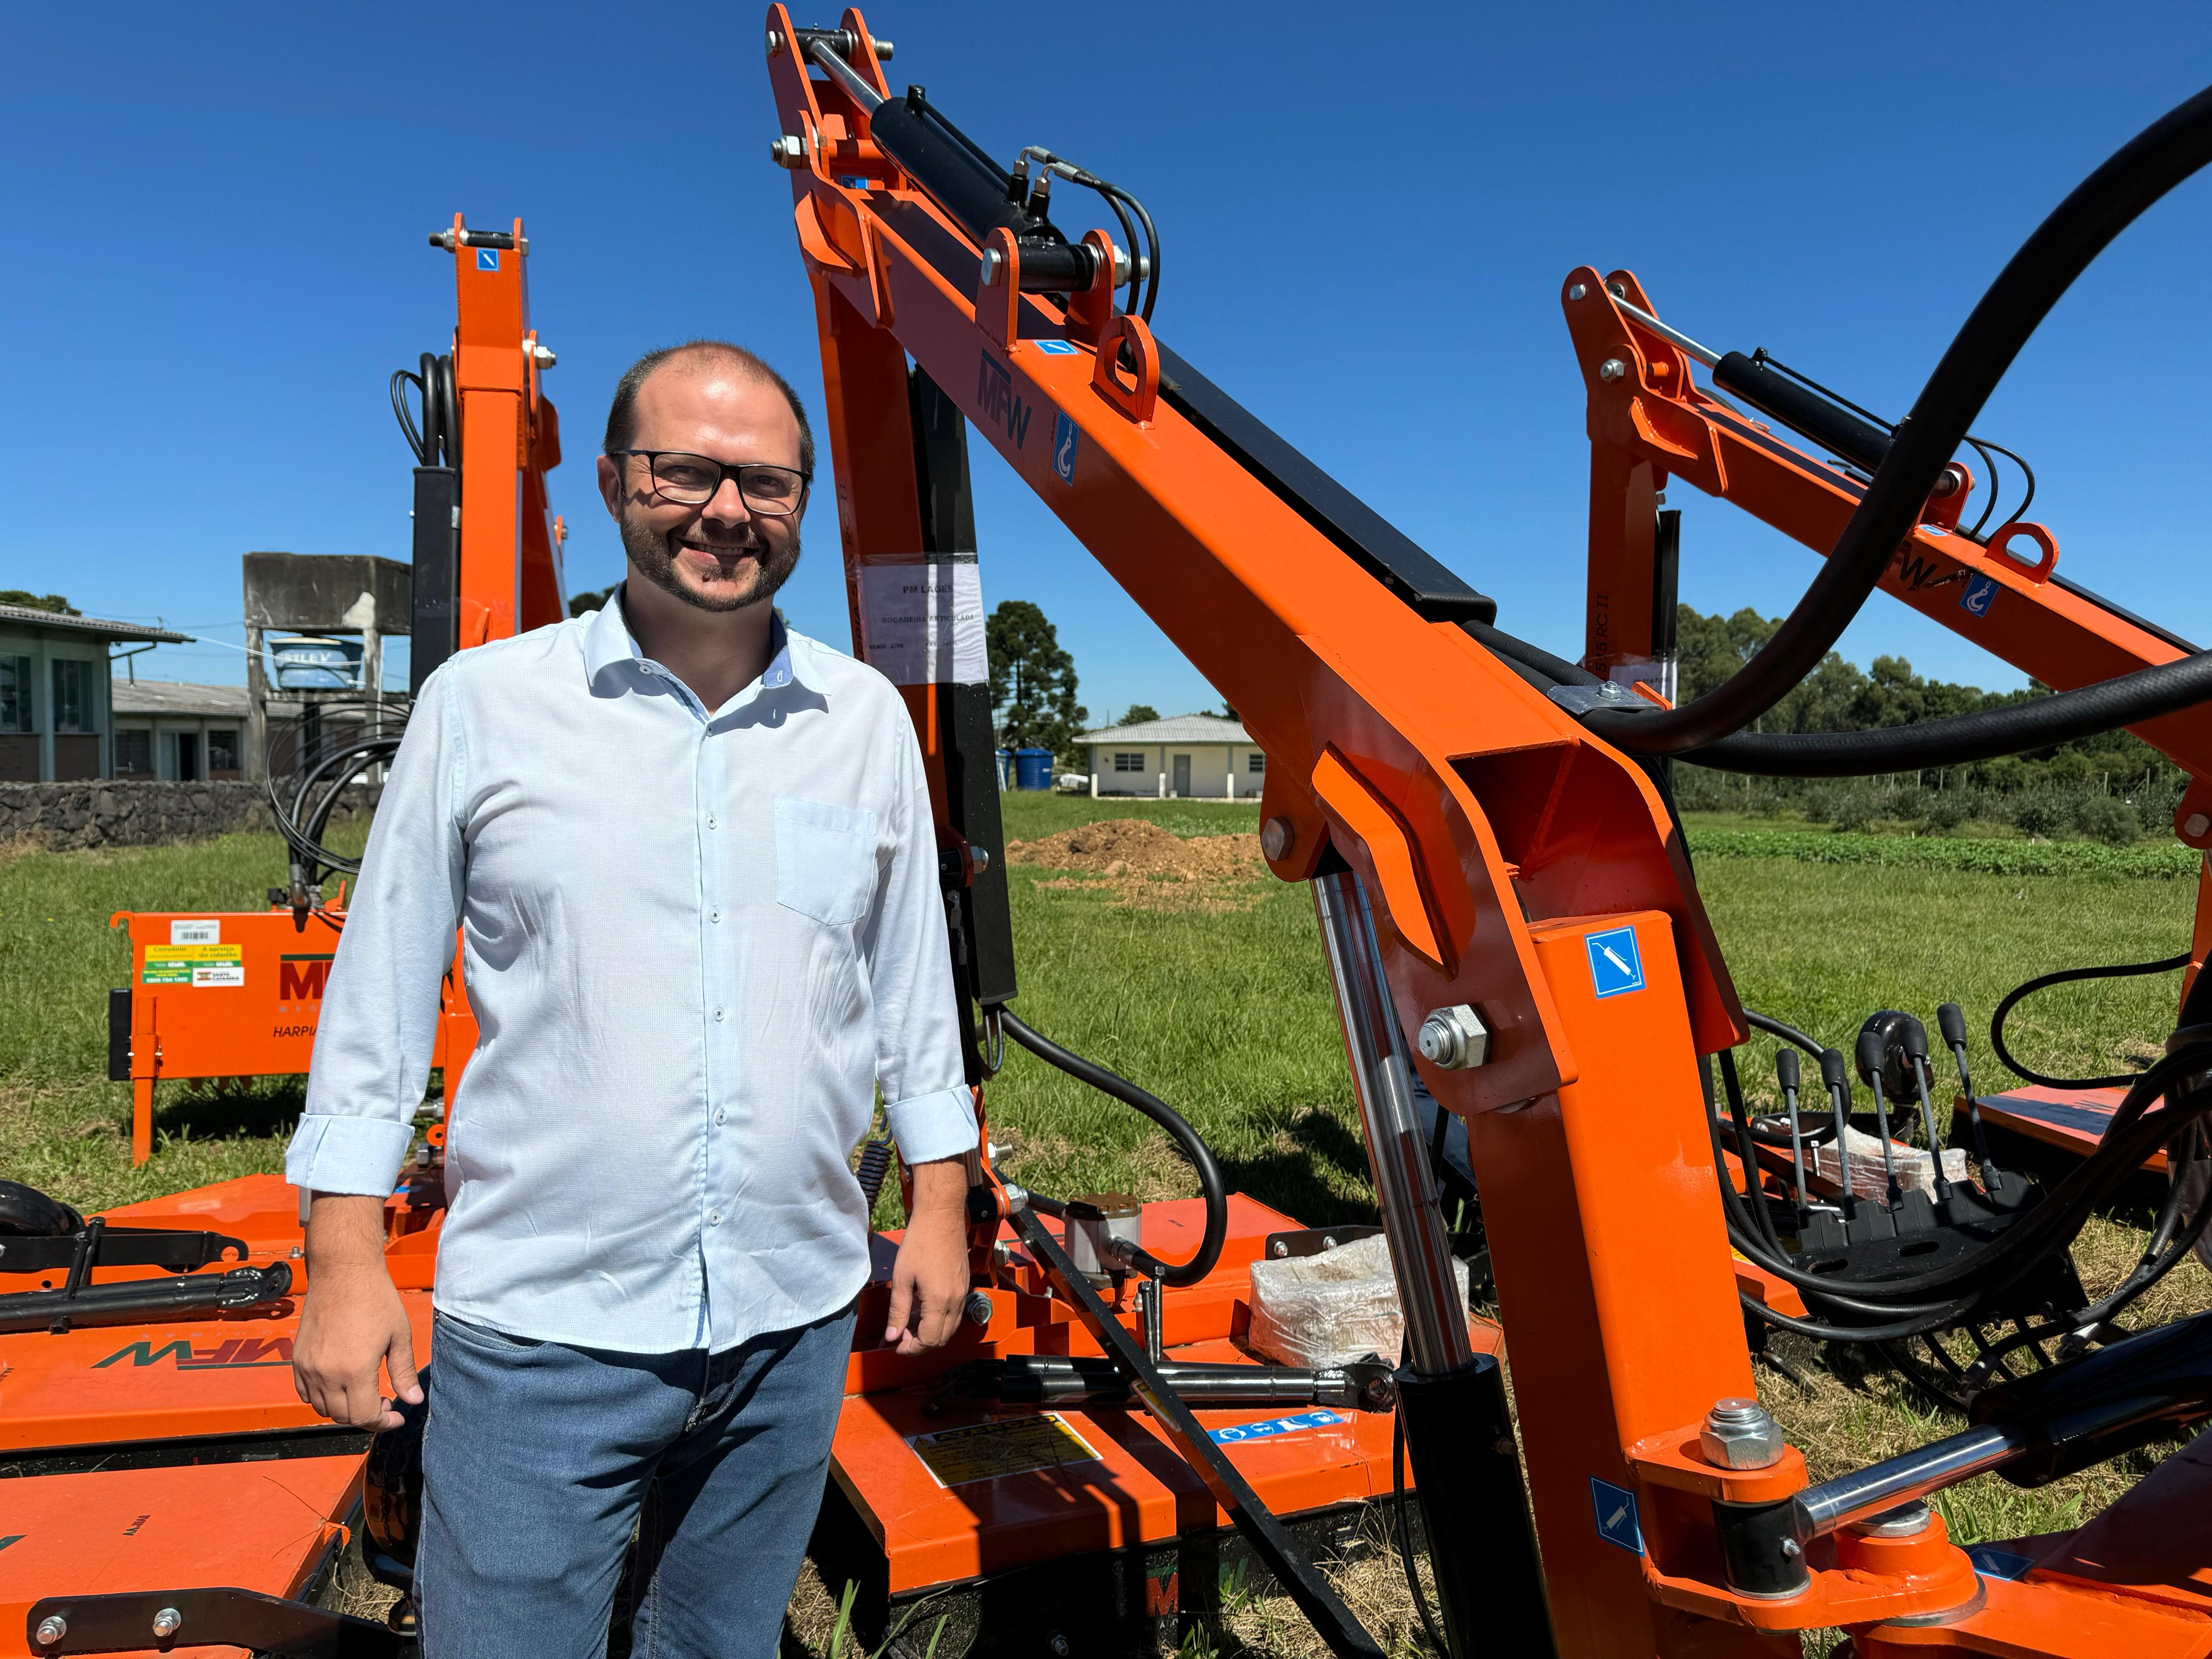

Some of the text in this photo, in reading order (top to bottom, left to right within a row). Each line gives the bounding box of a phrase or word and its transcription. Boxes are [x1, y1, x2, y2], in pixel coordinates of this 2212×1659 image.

[977, 358, 1032, 450] MFW
[843, 511, 852, 545] RC
[1887, 544, 1938, 588] FW
[903, 584, 953, 594] PM LAGES
[1597, 592, 1608, 609] II
[853, 605, 865, 663] RPIA
[928, 614, 975, 623] ARTICULADA
[1597, 613, 1608, 639] RC
[280, 961, 332, 1000] M
[90, 1337, 294, 1369] MFW
